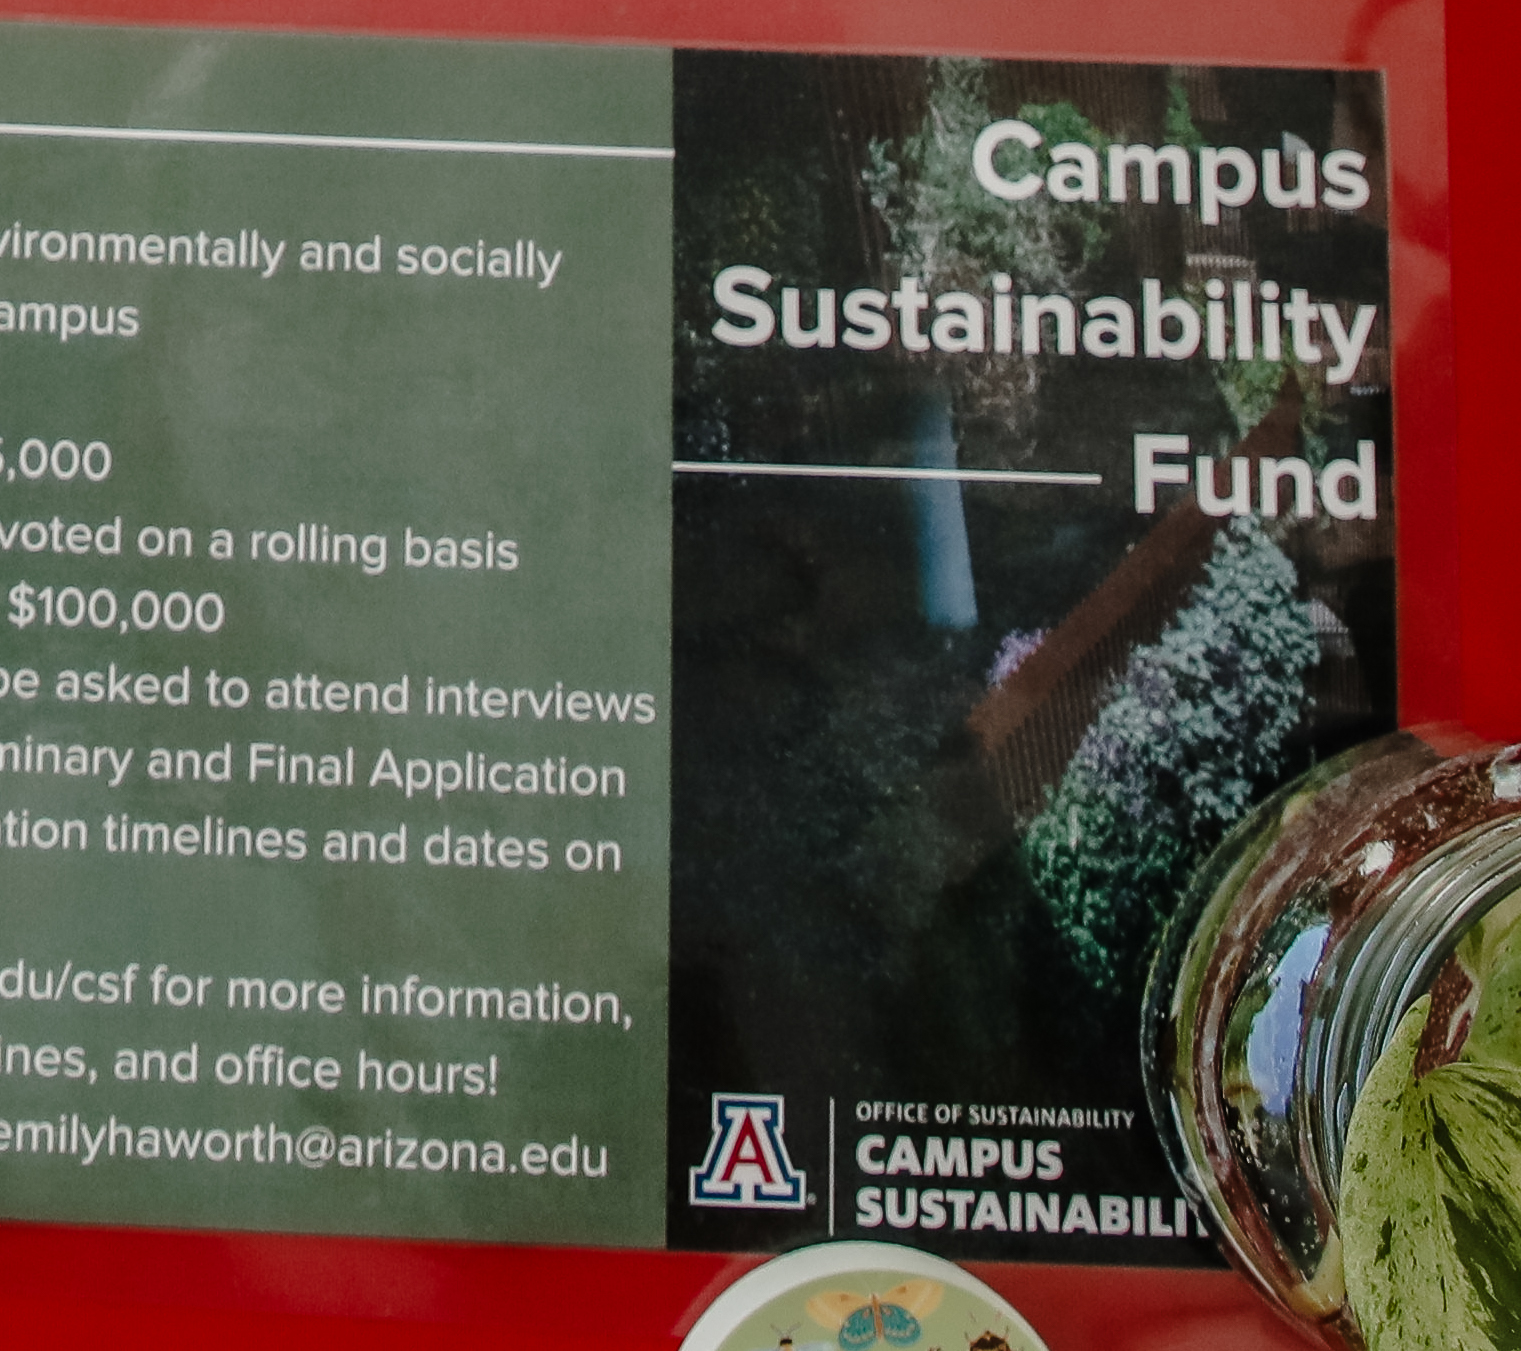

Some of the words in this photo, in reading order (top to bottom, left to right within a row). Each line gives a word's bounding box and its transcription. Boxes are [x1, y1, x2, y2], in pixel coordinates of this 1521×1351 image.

[972, 119, 1371, 226] Campus
[298, 232, 382, 274] and
[395, 238, 563, 290] socially
[711, 263, 1377, 385] Sustainability
[1132, 432, 1378, 521] Fund
[136, 524, 193, 558] on
[207, 528, 235, 560] a
[249, 521, 388, 576] rolling
[403, 525, 519, 571] basis
[7, 579, 226, 634] $100,000
[54, 661, 191, 707] asked
[204, 668, 250, 709] to
[263, 671, 410, 714] attend
[425, 675, 656, 725] interviews
[146, 741, 232, 783] and
[247, 741, 355, 787] Final
[368, 746, 626, 800] Application
[101, 812, 308, 861] timelines
[321, 822, 408, 864] and
[421, 824, 551, 871] dates
[563, 838, 622, 872] on
[148, 962, 214, 1007] for
[226, 975, 346, 1014] more
[361, 973, 633, 1031] information,
[112, 1041, 199, 1084] and
[213, 1042, 343, 1091] office
[356, 1048, 499, 1098] hours!
[855, 1100, 929, 1125] OFFICE
[934, 1102, 961, 1126] OF
[967, 1105, 1136, 1130] SUSTAINABILITY
[855, 1134, 1065, 1181] CAMPUS
